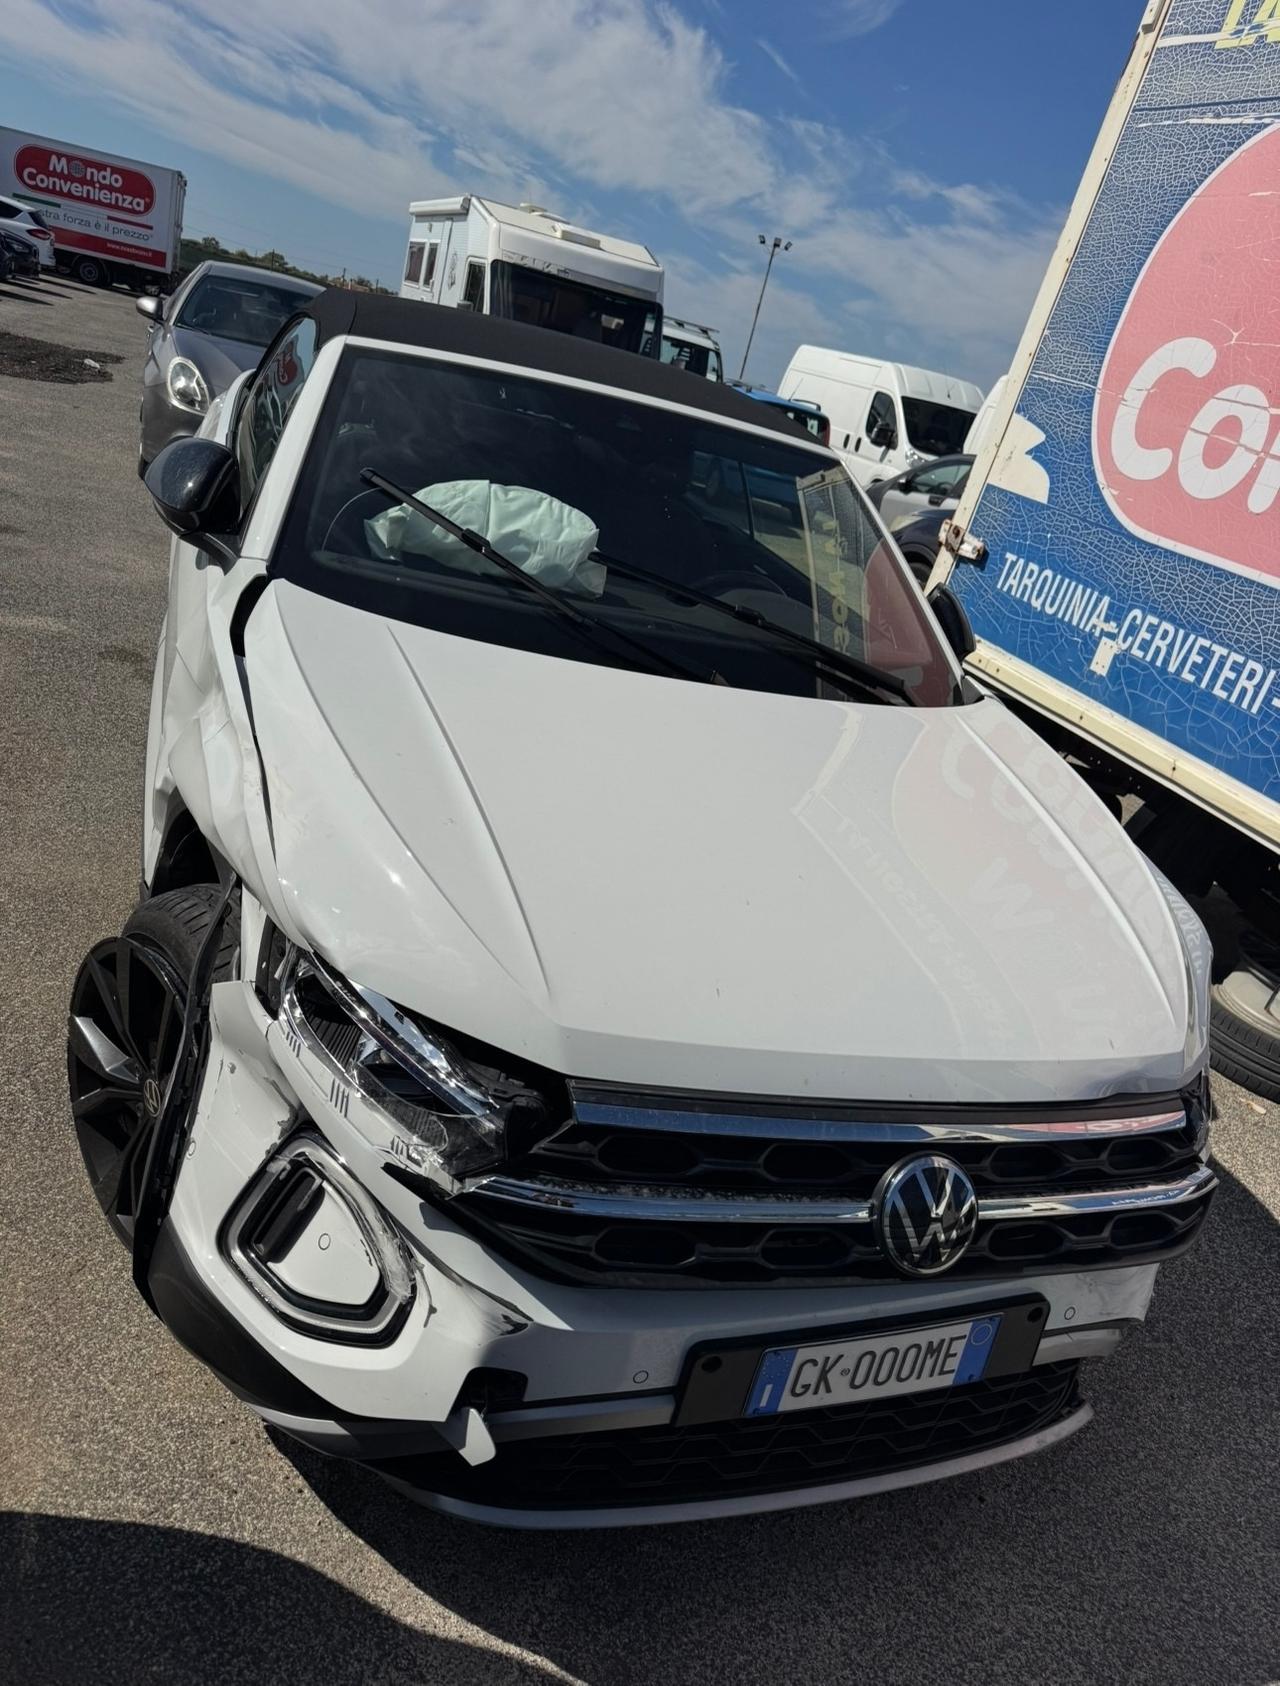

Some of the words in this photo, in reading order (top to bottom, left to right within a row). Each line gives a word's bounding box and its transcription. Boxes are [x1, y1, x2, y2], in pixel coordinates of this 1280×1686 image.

[48, 154, 122, 188] Mondo
[22, 167, 145, 212] Convenienza
[62, 212, 91, 228] forza
[112, 226, 150, 241] prezzo
